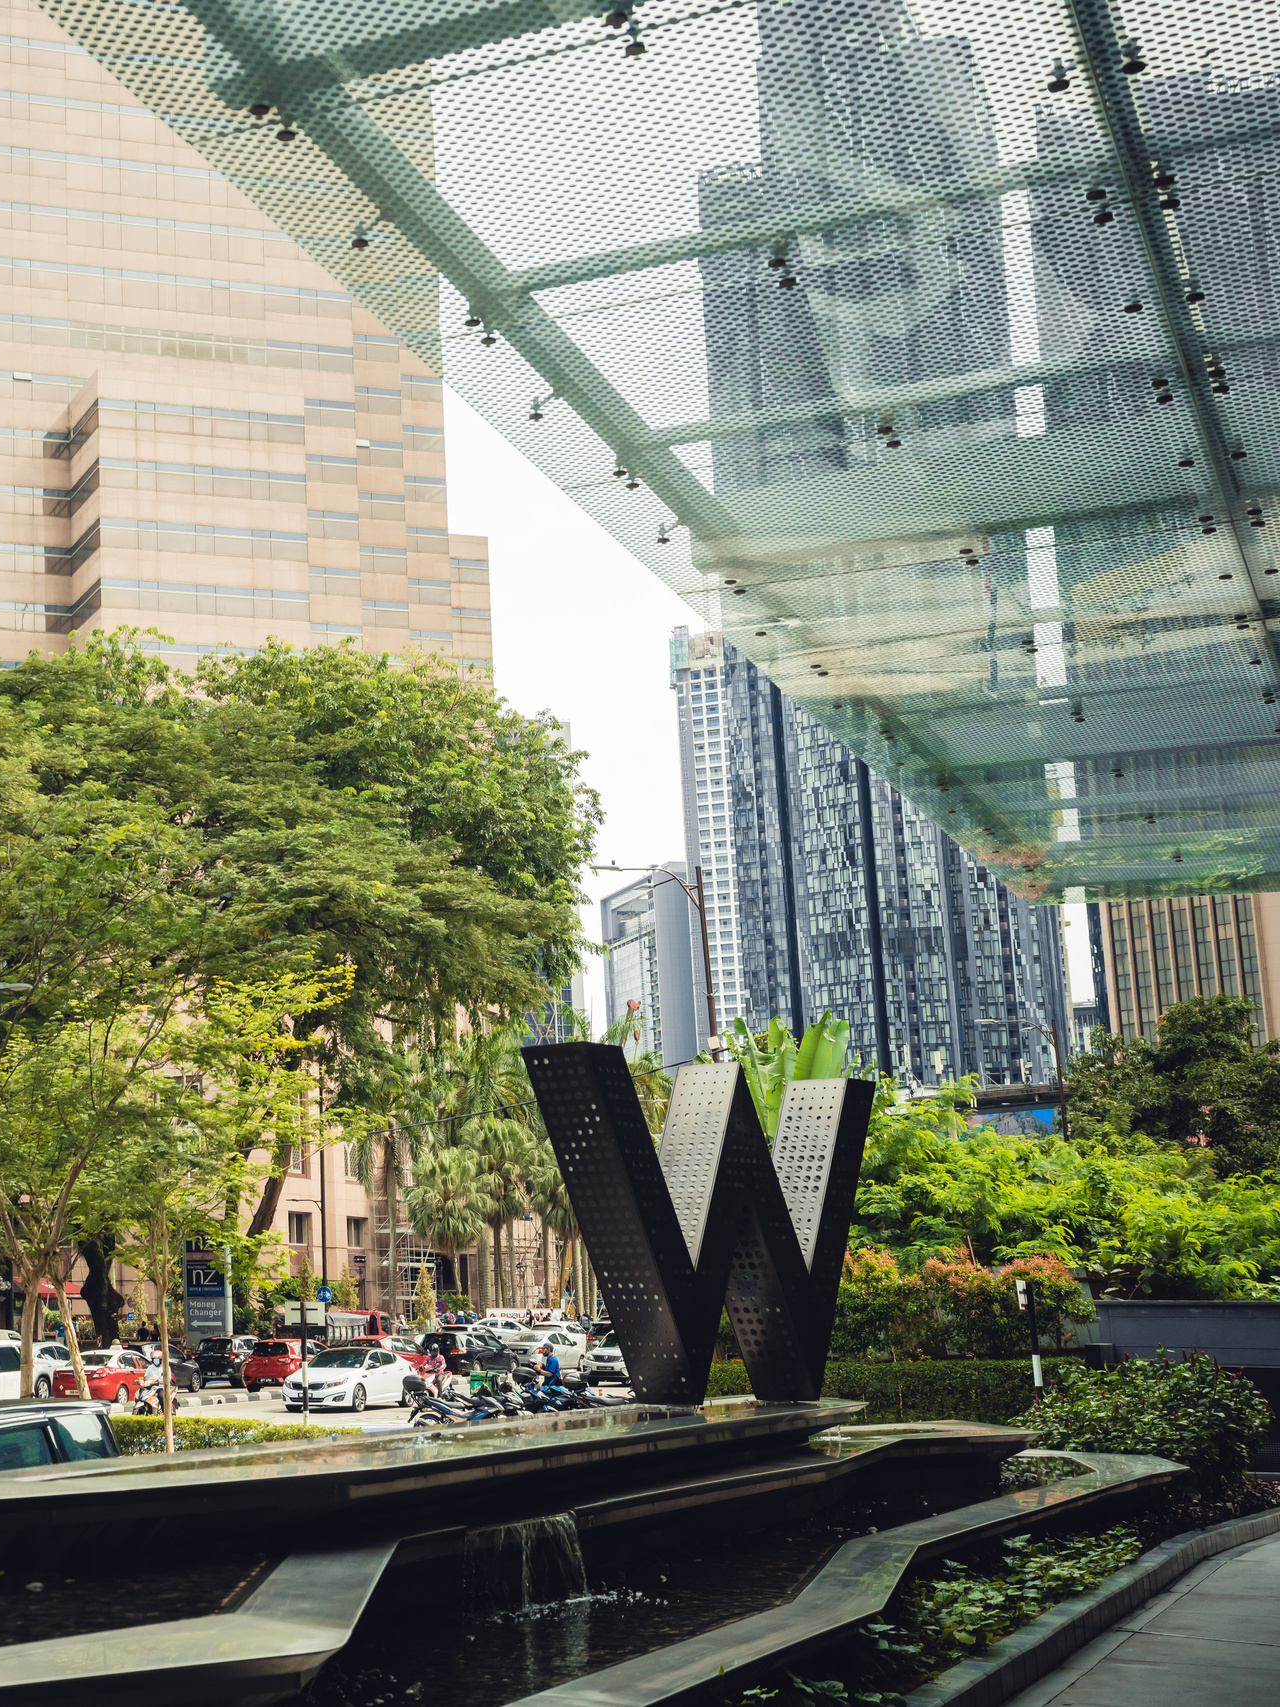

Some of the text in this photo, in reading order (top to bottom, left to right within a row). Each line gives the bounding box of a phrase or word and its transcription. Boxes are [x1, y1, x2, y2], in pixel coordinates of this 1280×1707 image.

[522, 1041, 876, 1405] W
[192, 1269, 218, 1285] nz
[189, 1301, 216, 1310] Money
[189, 1308, 223, 1318] Changer
